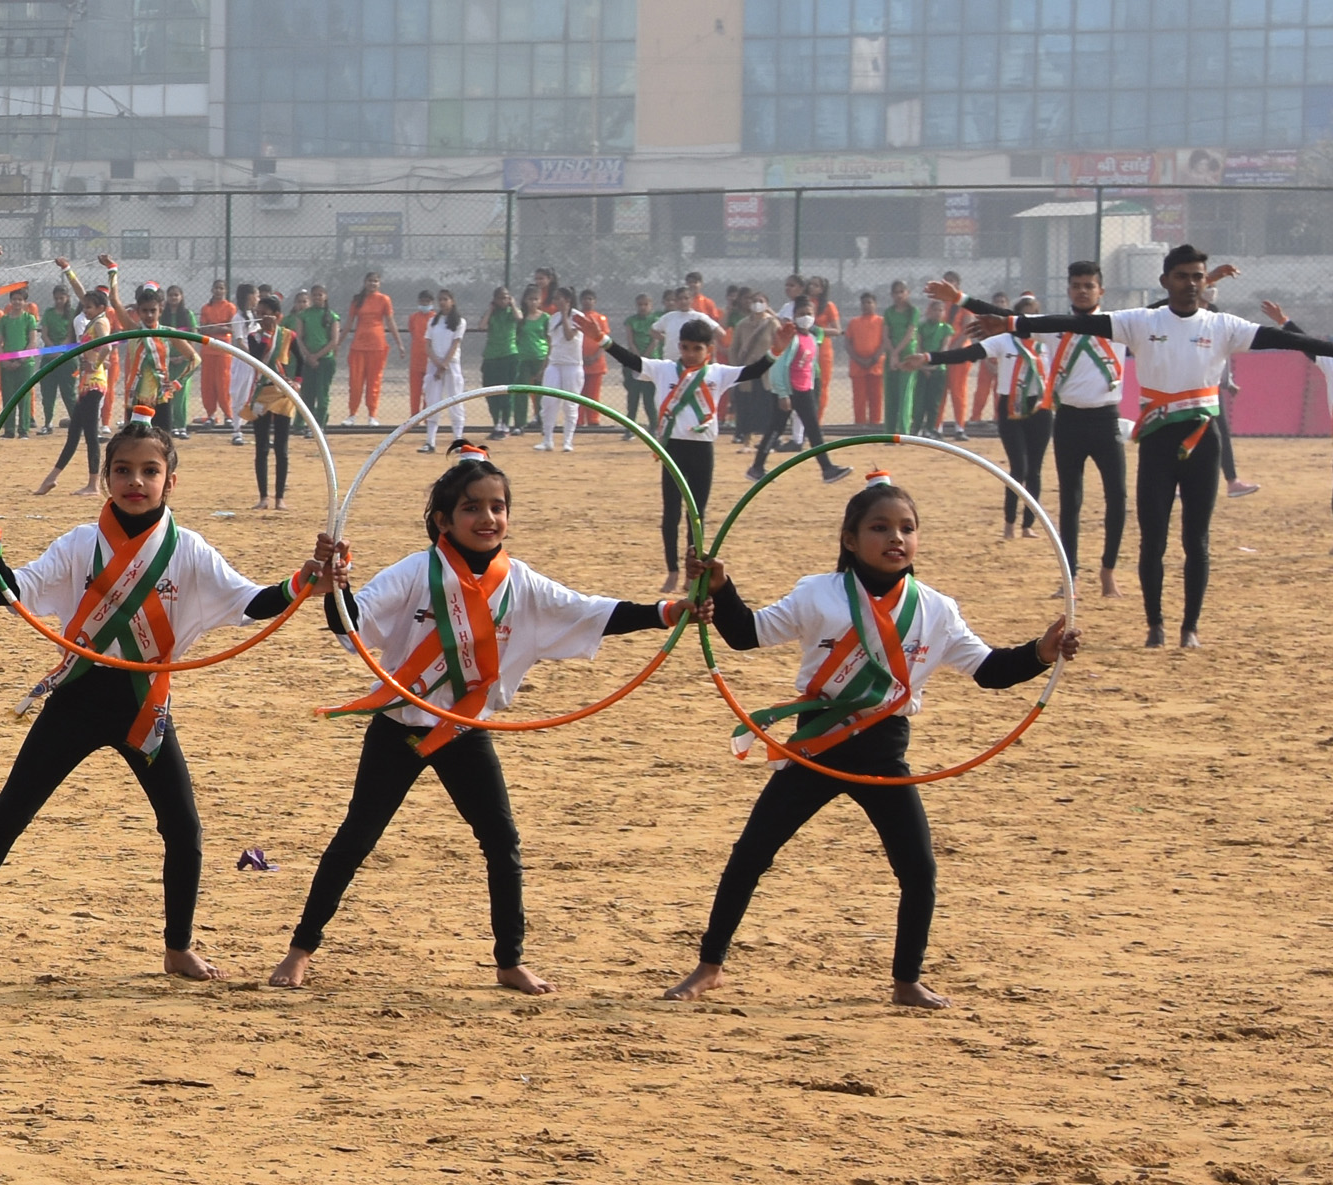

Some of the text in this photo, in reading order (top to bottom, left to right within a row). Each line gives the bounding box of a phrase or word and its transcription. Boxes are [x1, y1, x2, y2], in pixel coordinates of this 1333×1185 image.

[1097, 156, 1116, 172] श्री
[93, 560, 144, 621] JAI HIND
[132, 611, 150, 650] HIND
[451, 593, 472, 669] JAI HIND
[834, 648, 867, 684] HIND
